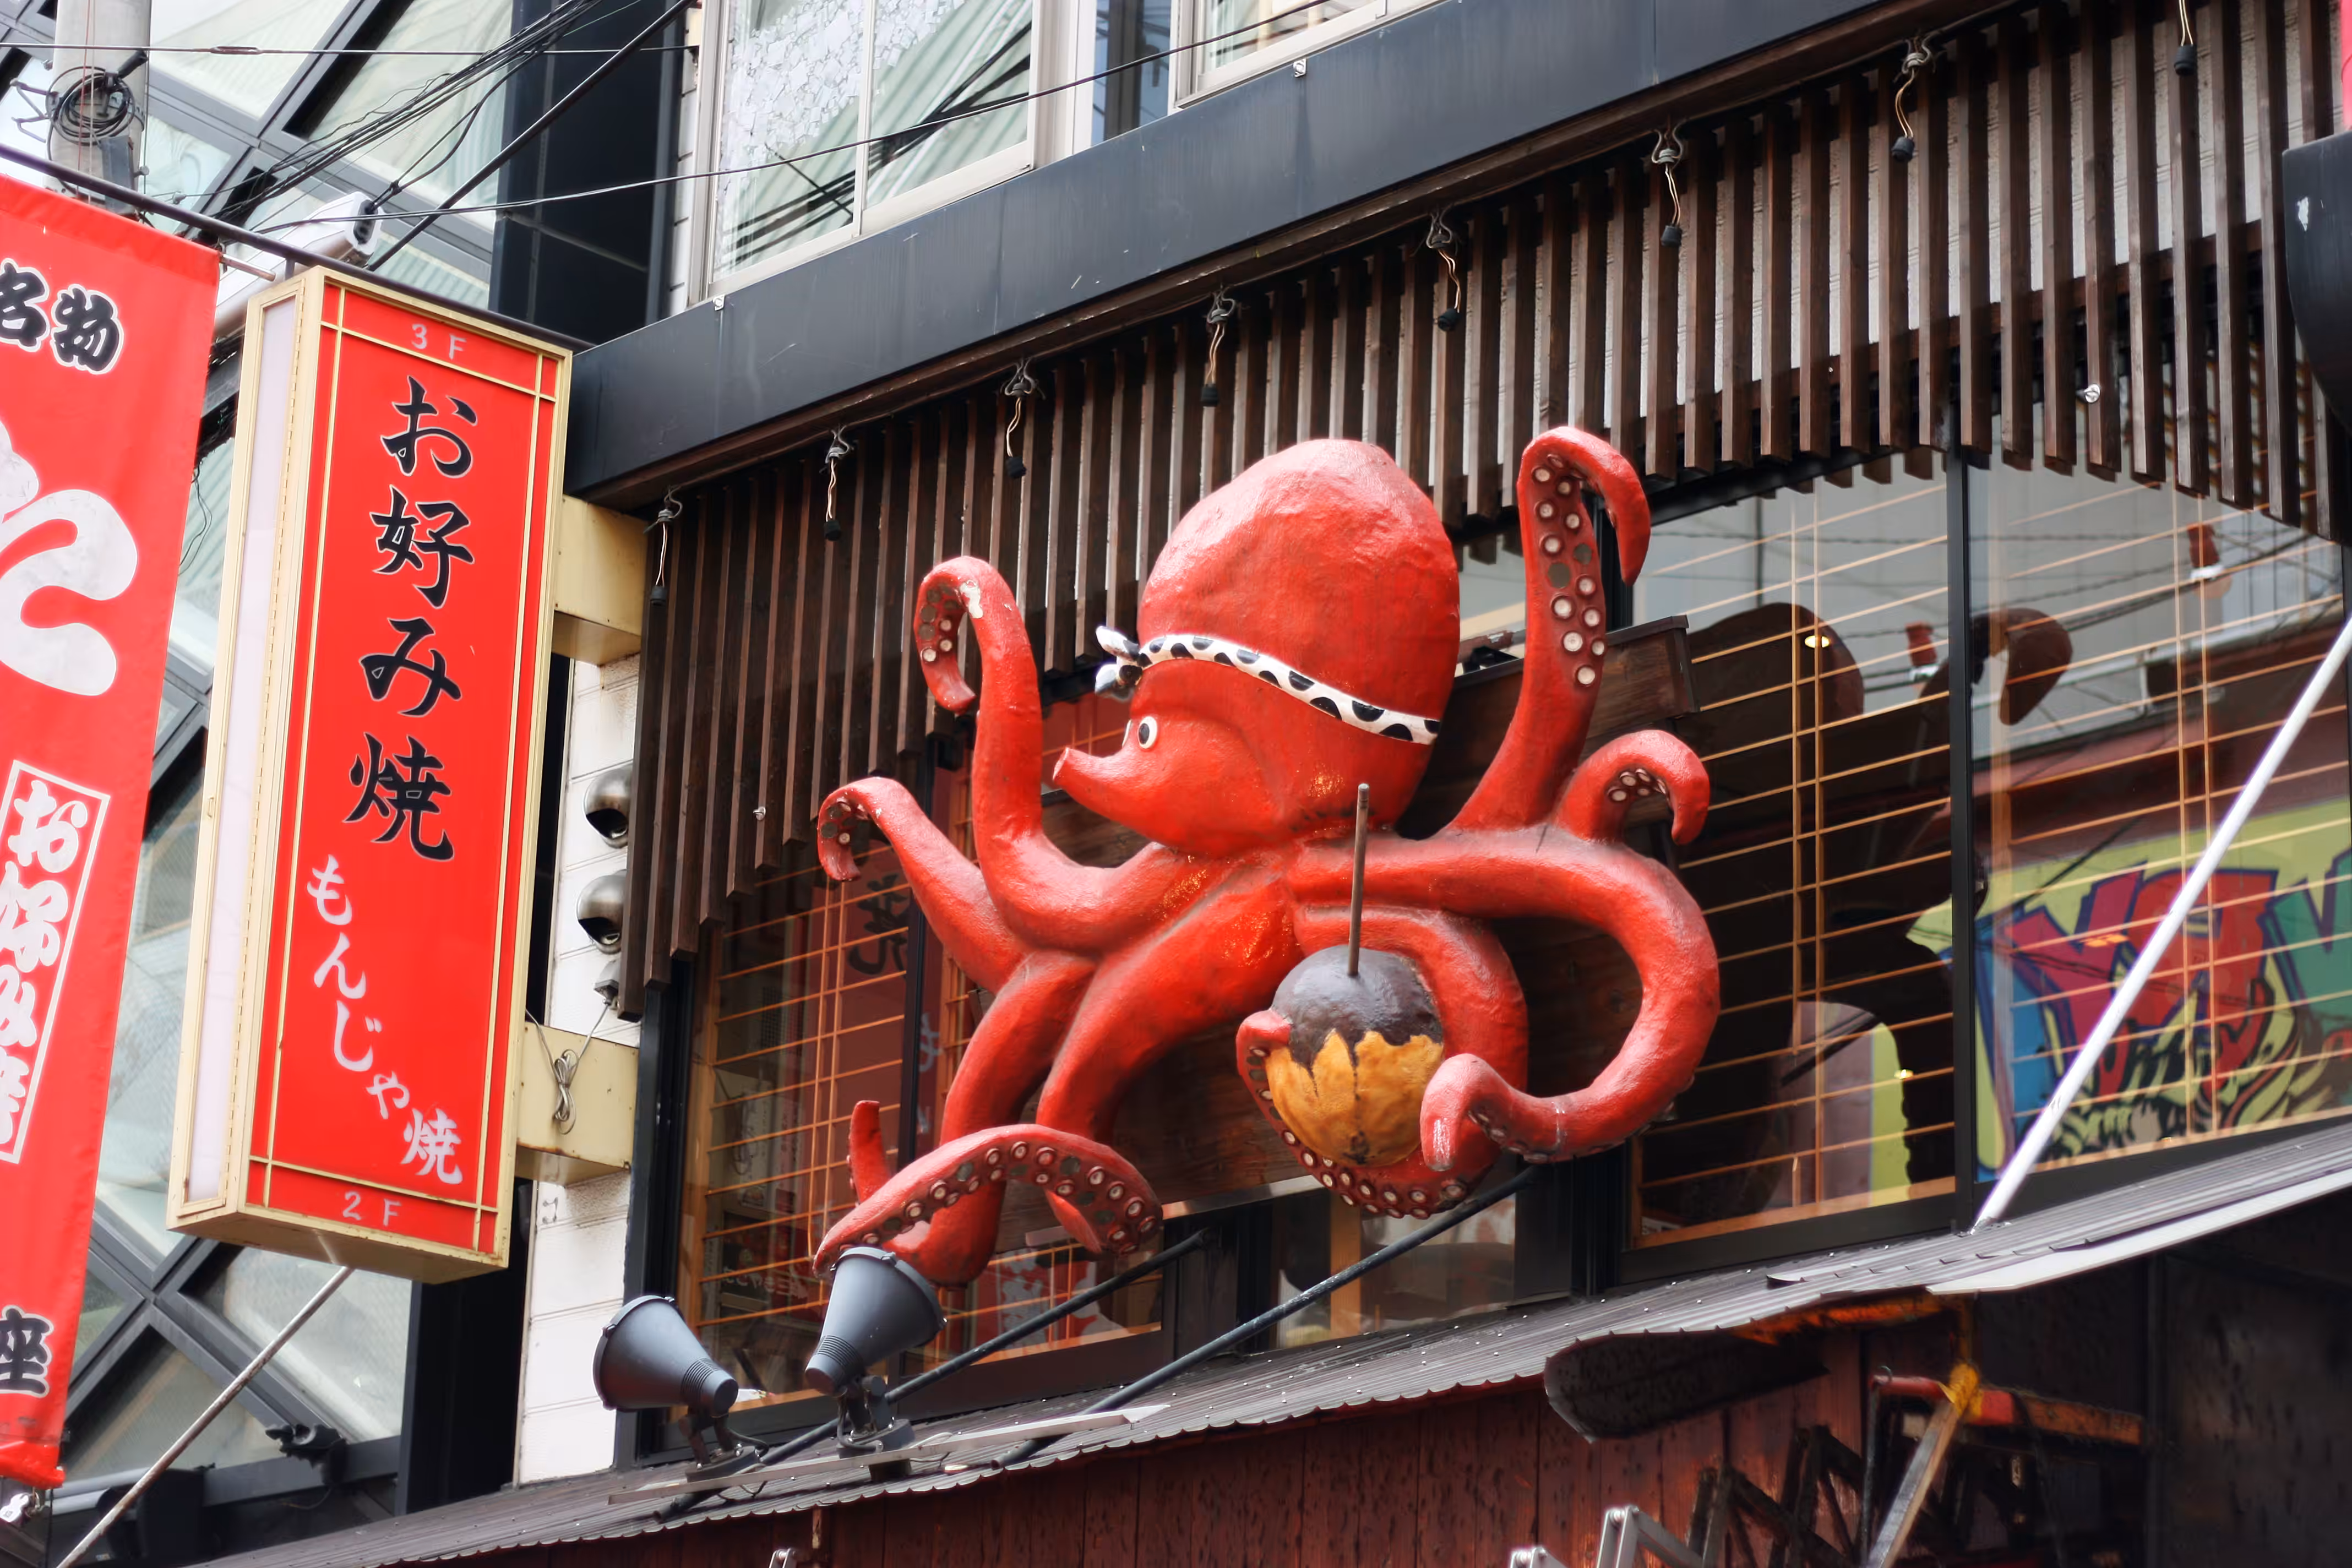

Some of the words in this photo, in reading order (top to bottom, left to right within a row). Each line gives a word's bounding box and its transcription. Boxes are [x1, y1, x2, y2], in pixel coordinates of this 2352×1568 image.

[0, 259, 124, 374] 名物
[342, 375, 477, 861] お好み焼
[306, 854, 463, 1185] もんじゃ焼
